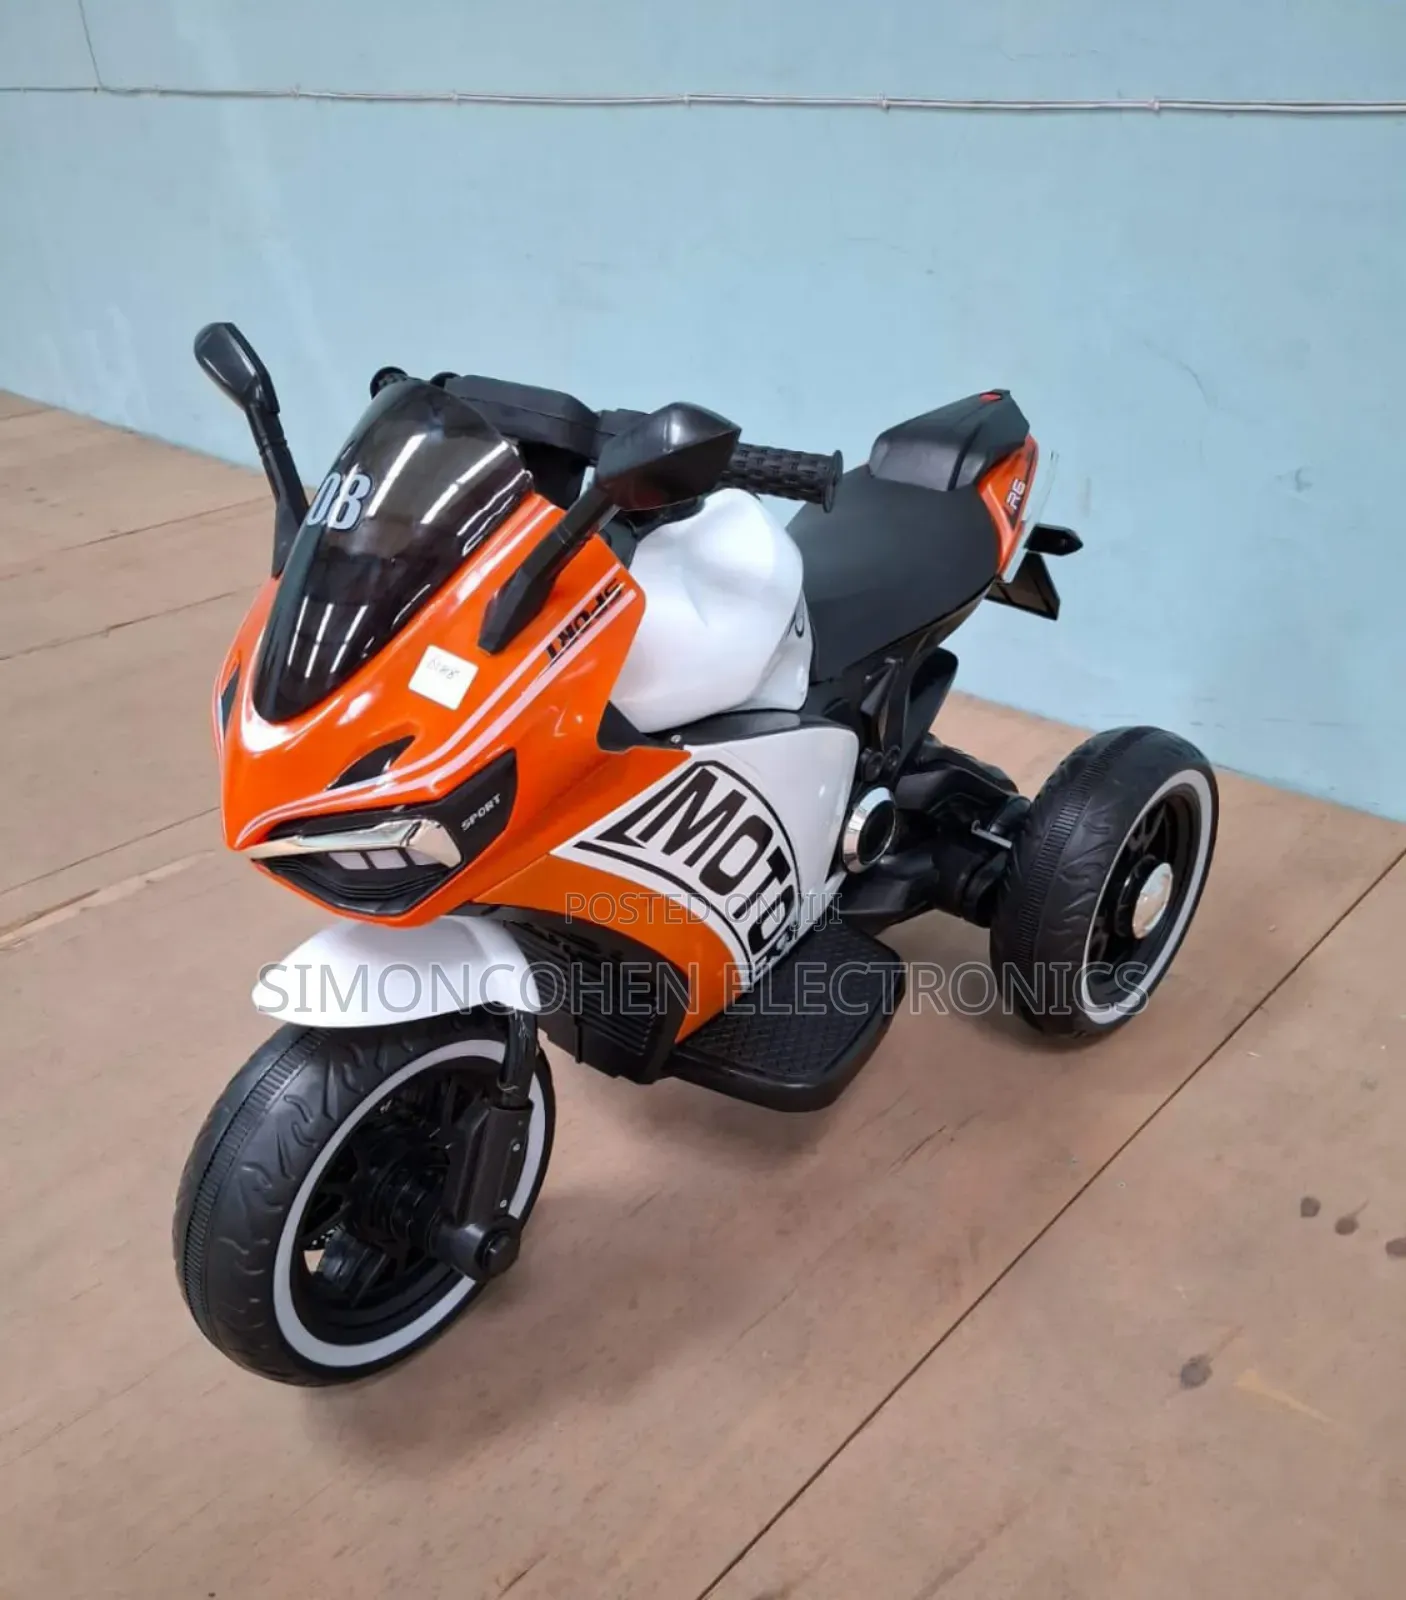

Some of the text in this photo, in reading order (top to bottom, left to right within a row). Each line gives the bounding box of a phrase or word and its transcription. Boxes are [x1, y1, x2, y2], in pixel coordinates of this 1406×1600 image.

[305, 472, 373, 532] 08
[1005, 478, 1026, 510] R6
[460, 793, 501, 831] SPORT
[636, 768, 794, 955] MOTO
